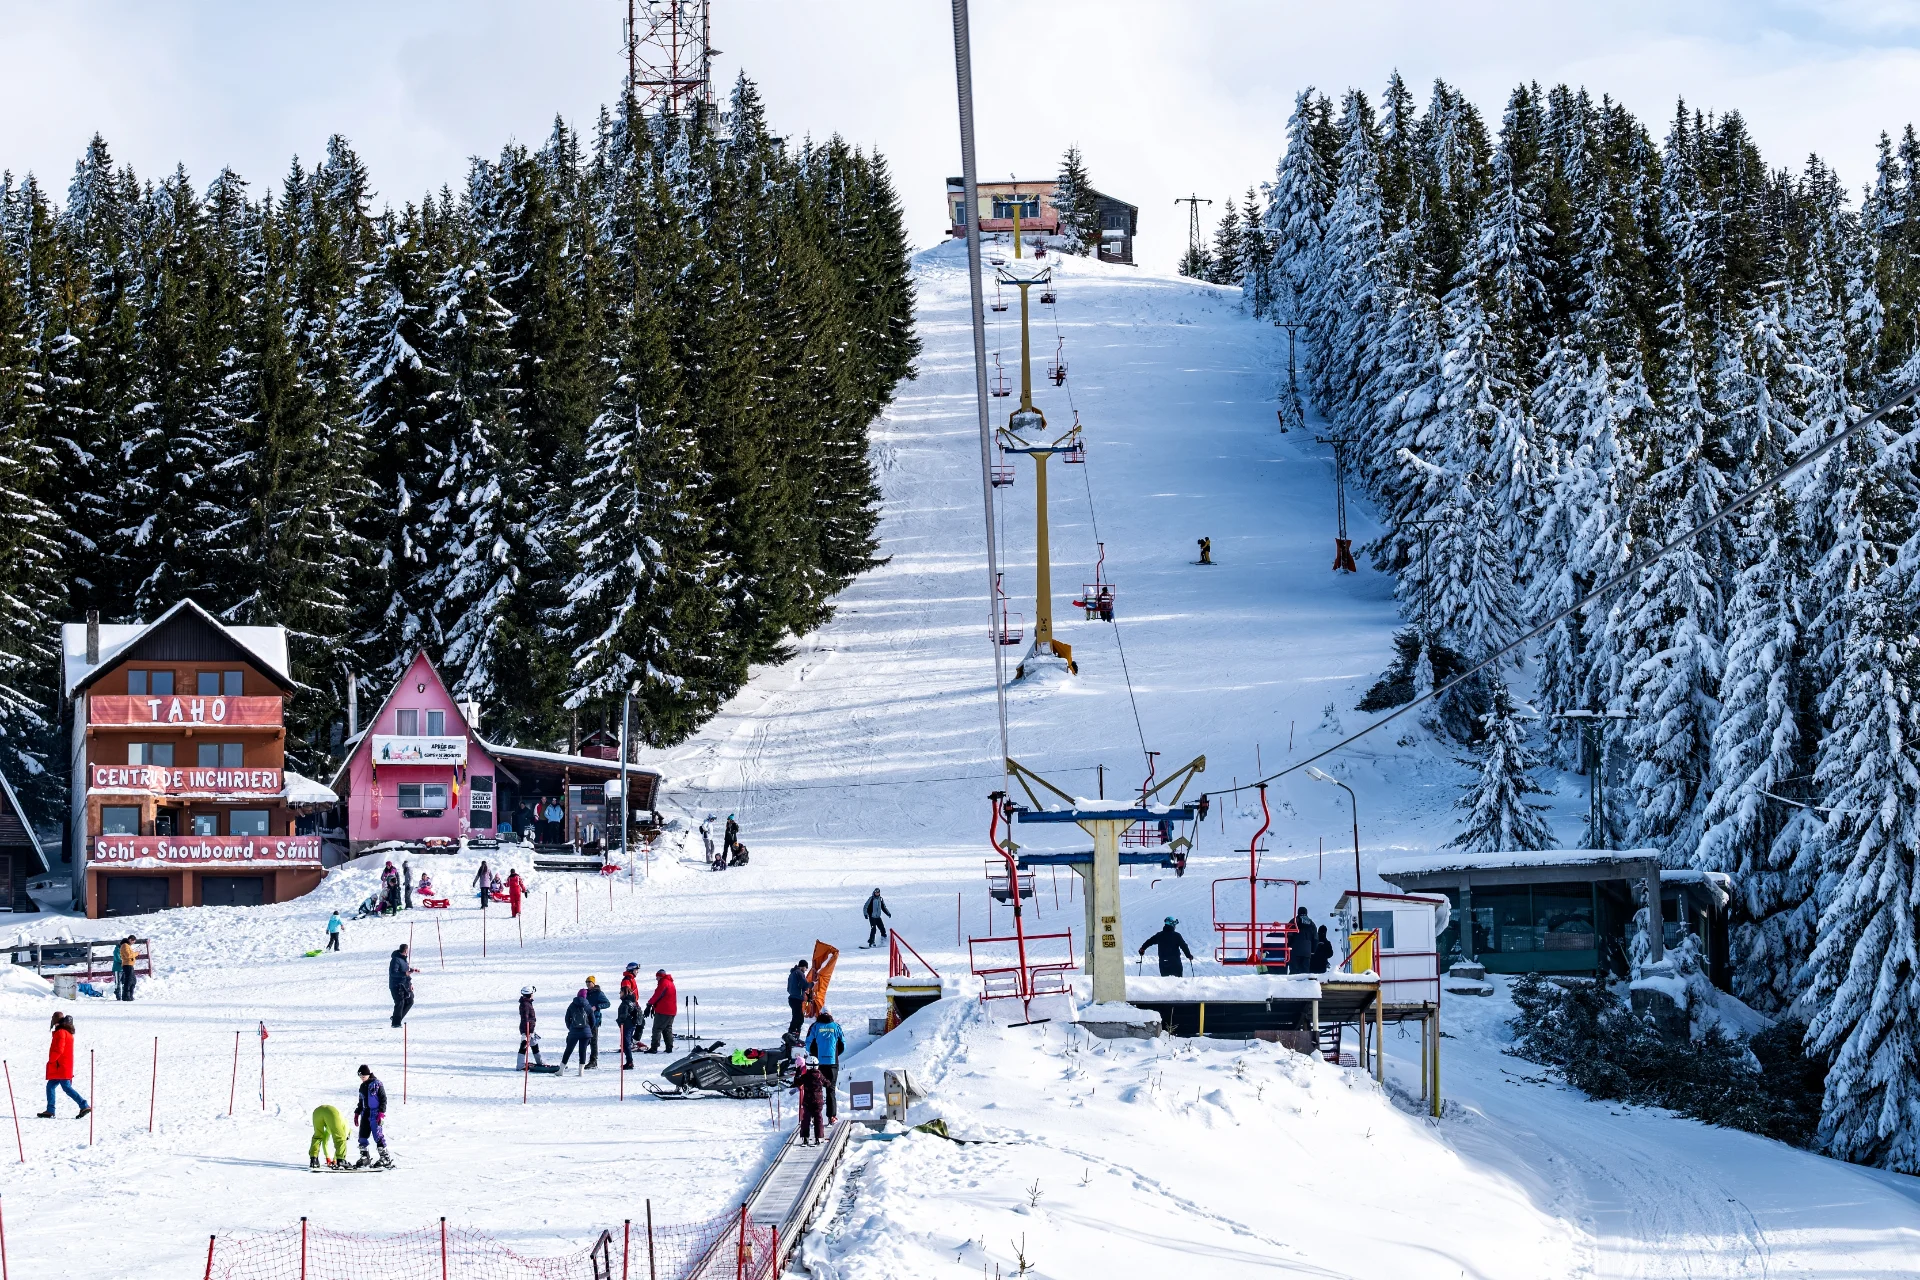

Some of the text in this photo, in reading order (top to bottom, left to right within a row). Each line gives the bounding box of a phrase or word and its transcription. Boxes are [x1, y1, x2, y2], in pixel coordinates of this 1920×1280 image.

[148, 697, 226, 723] TAHO
[162, 770, 183, 788] DE
[190, 770, 278, 789] INCHIRIERI
[96, 840, 319, 860] Schi Snowboard Sănii
